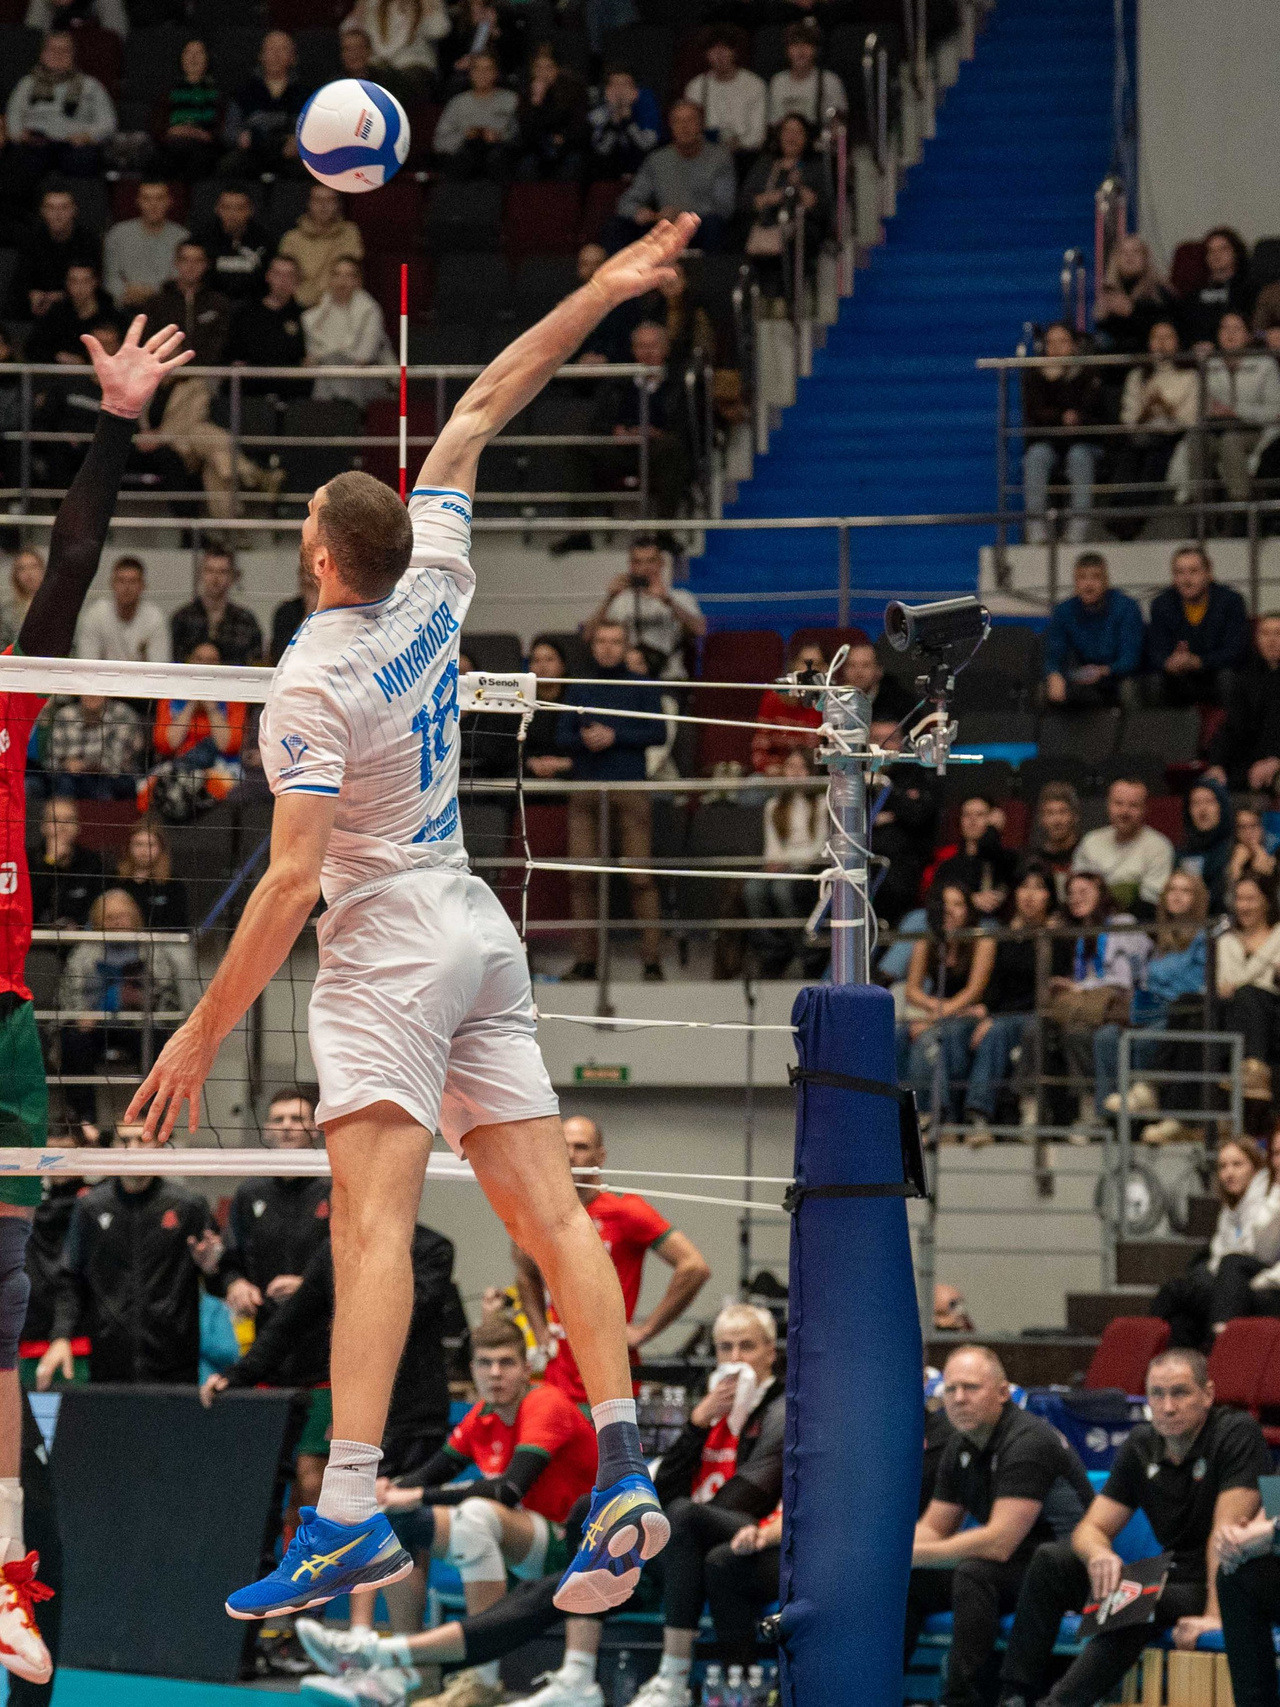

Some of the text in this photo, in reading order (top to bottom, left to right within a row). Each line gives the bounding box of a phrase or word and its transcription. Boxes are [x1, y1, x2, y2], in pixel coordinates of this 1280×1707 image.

[373, 600, 459, 704] МИХАЙЛОВ
[488, 678, 519, 688] Senoh
[412, 658, 460, 793] 18
